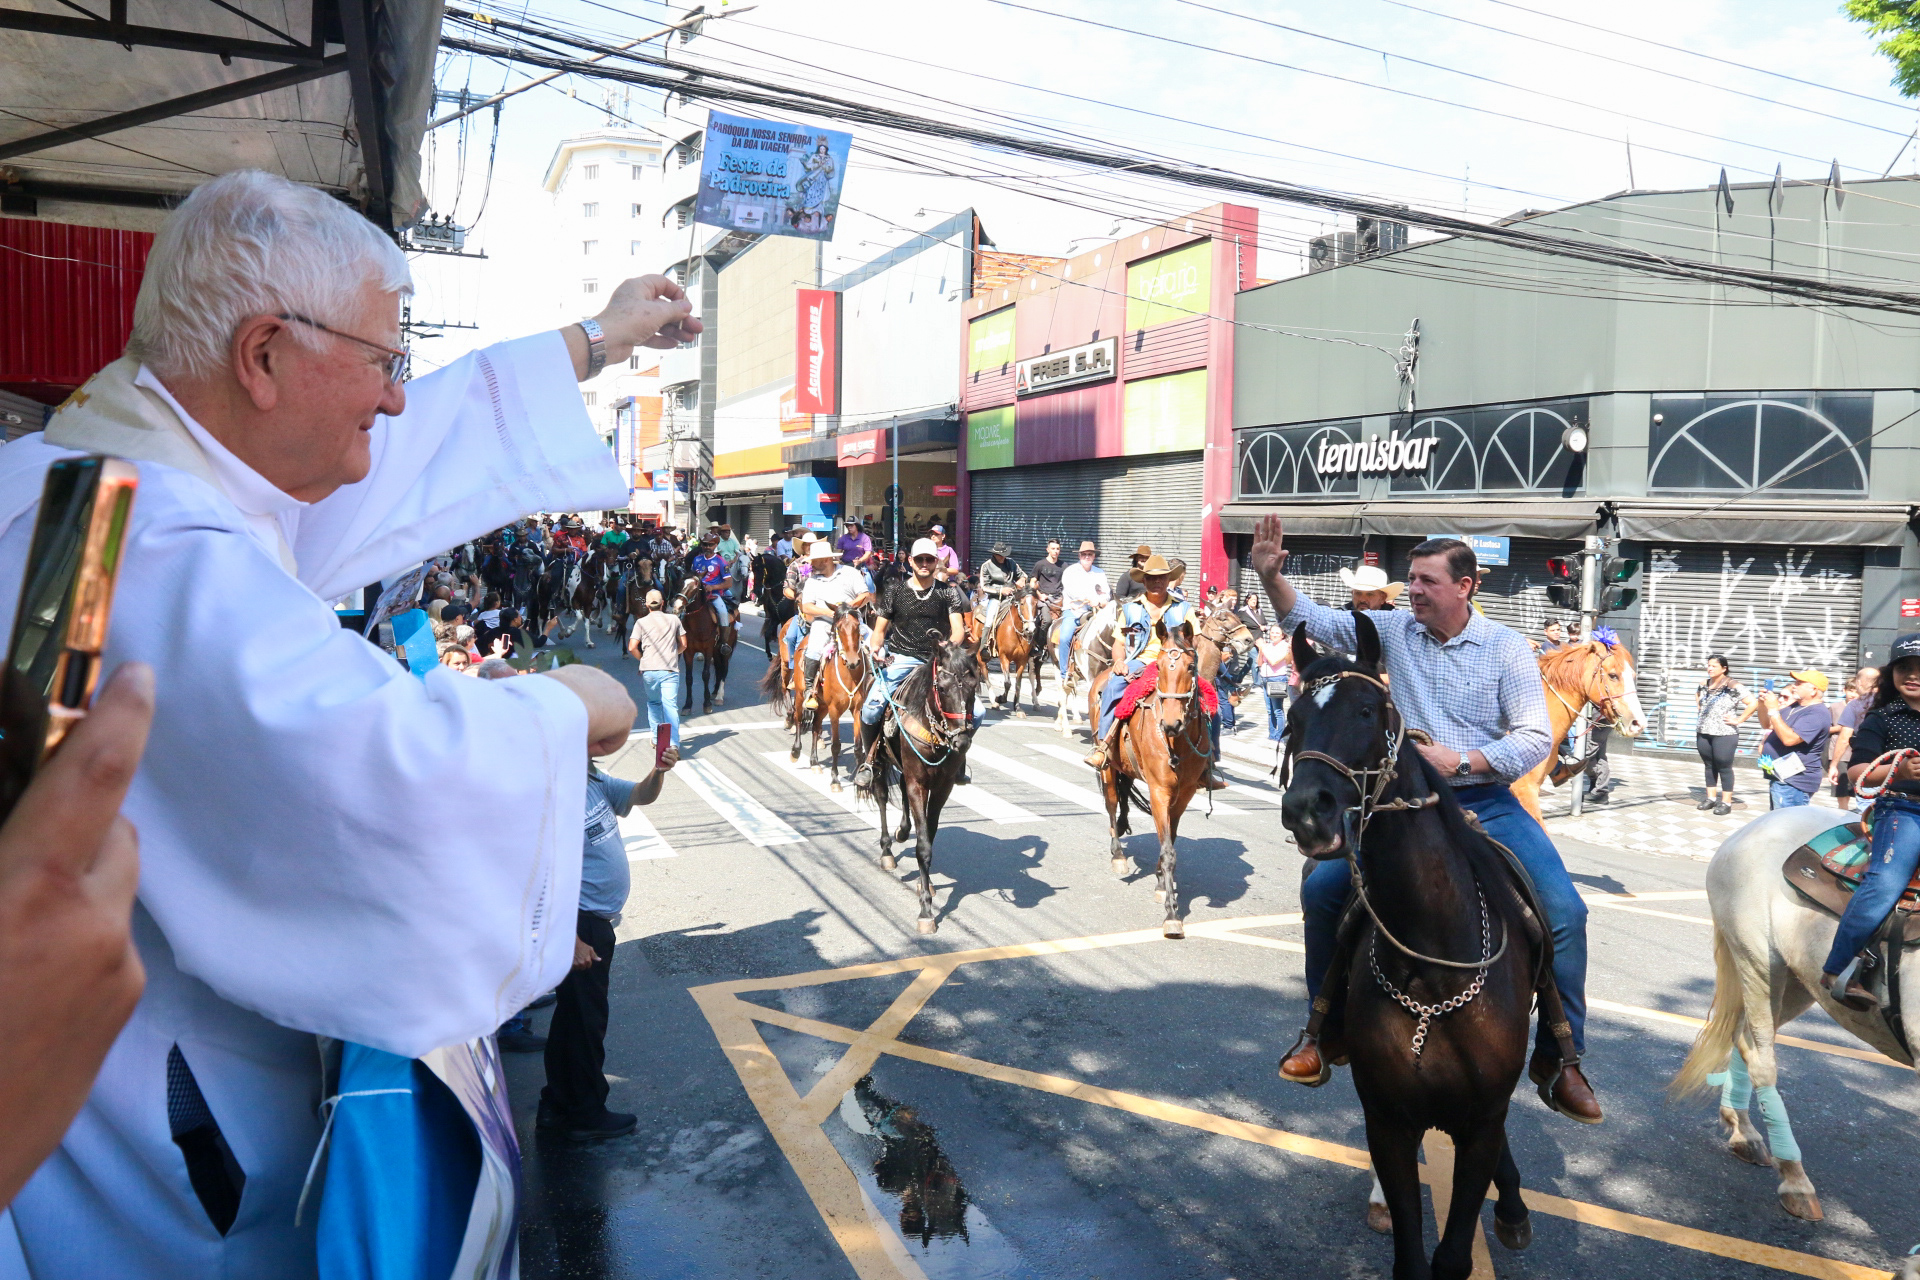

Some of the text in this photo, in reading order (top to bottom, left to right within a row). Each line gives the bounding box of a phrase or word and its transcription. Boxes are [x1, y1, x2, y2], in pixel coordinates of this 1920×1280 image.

[713, 121, 812, 146] PARÓQUIA NOSSA SENHORA
[731, 137, 790, 153] DA BOA VIAGEM
[718, 151, 788, 178] Festa da
[708, 170, 791, 199] Padroeira
[808, 305, 820, 398] ÁGUIA SHOES
[1030, 356, 1070, 382] FREE
[1075, 347, 1111, 373] S.A.
[974, 423, 1001, 440] MODARE
[1317, 430, 1438, 473] tennisbar
[1473, 538, 1501, 549] P. Lustosa
